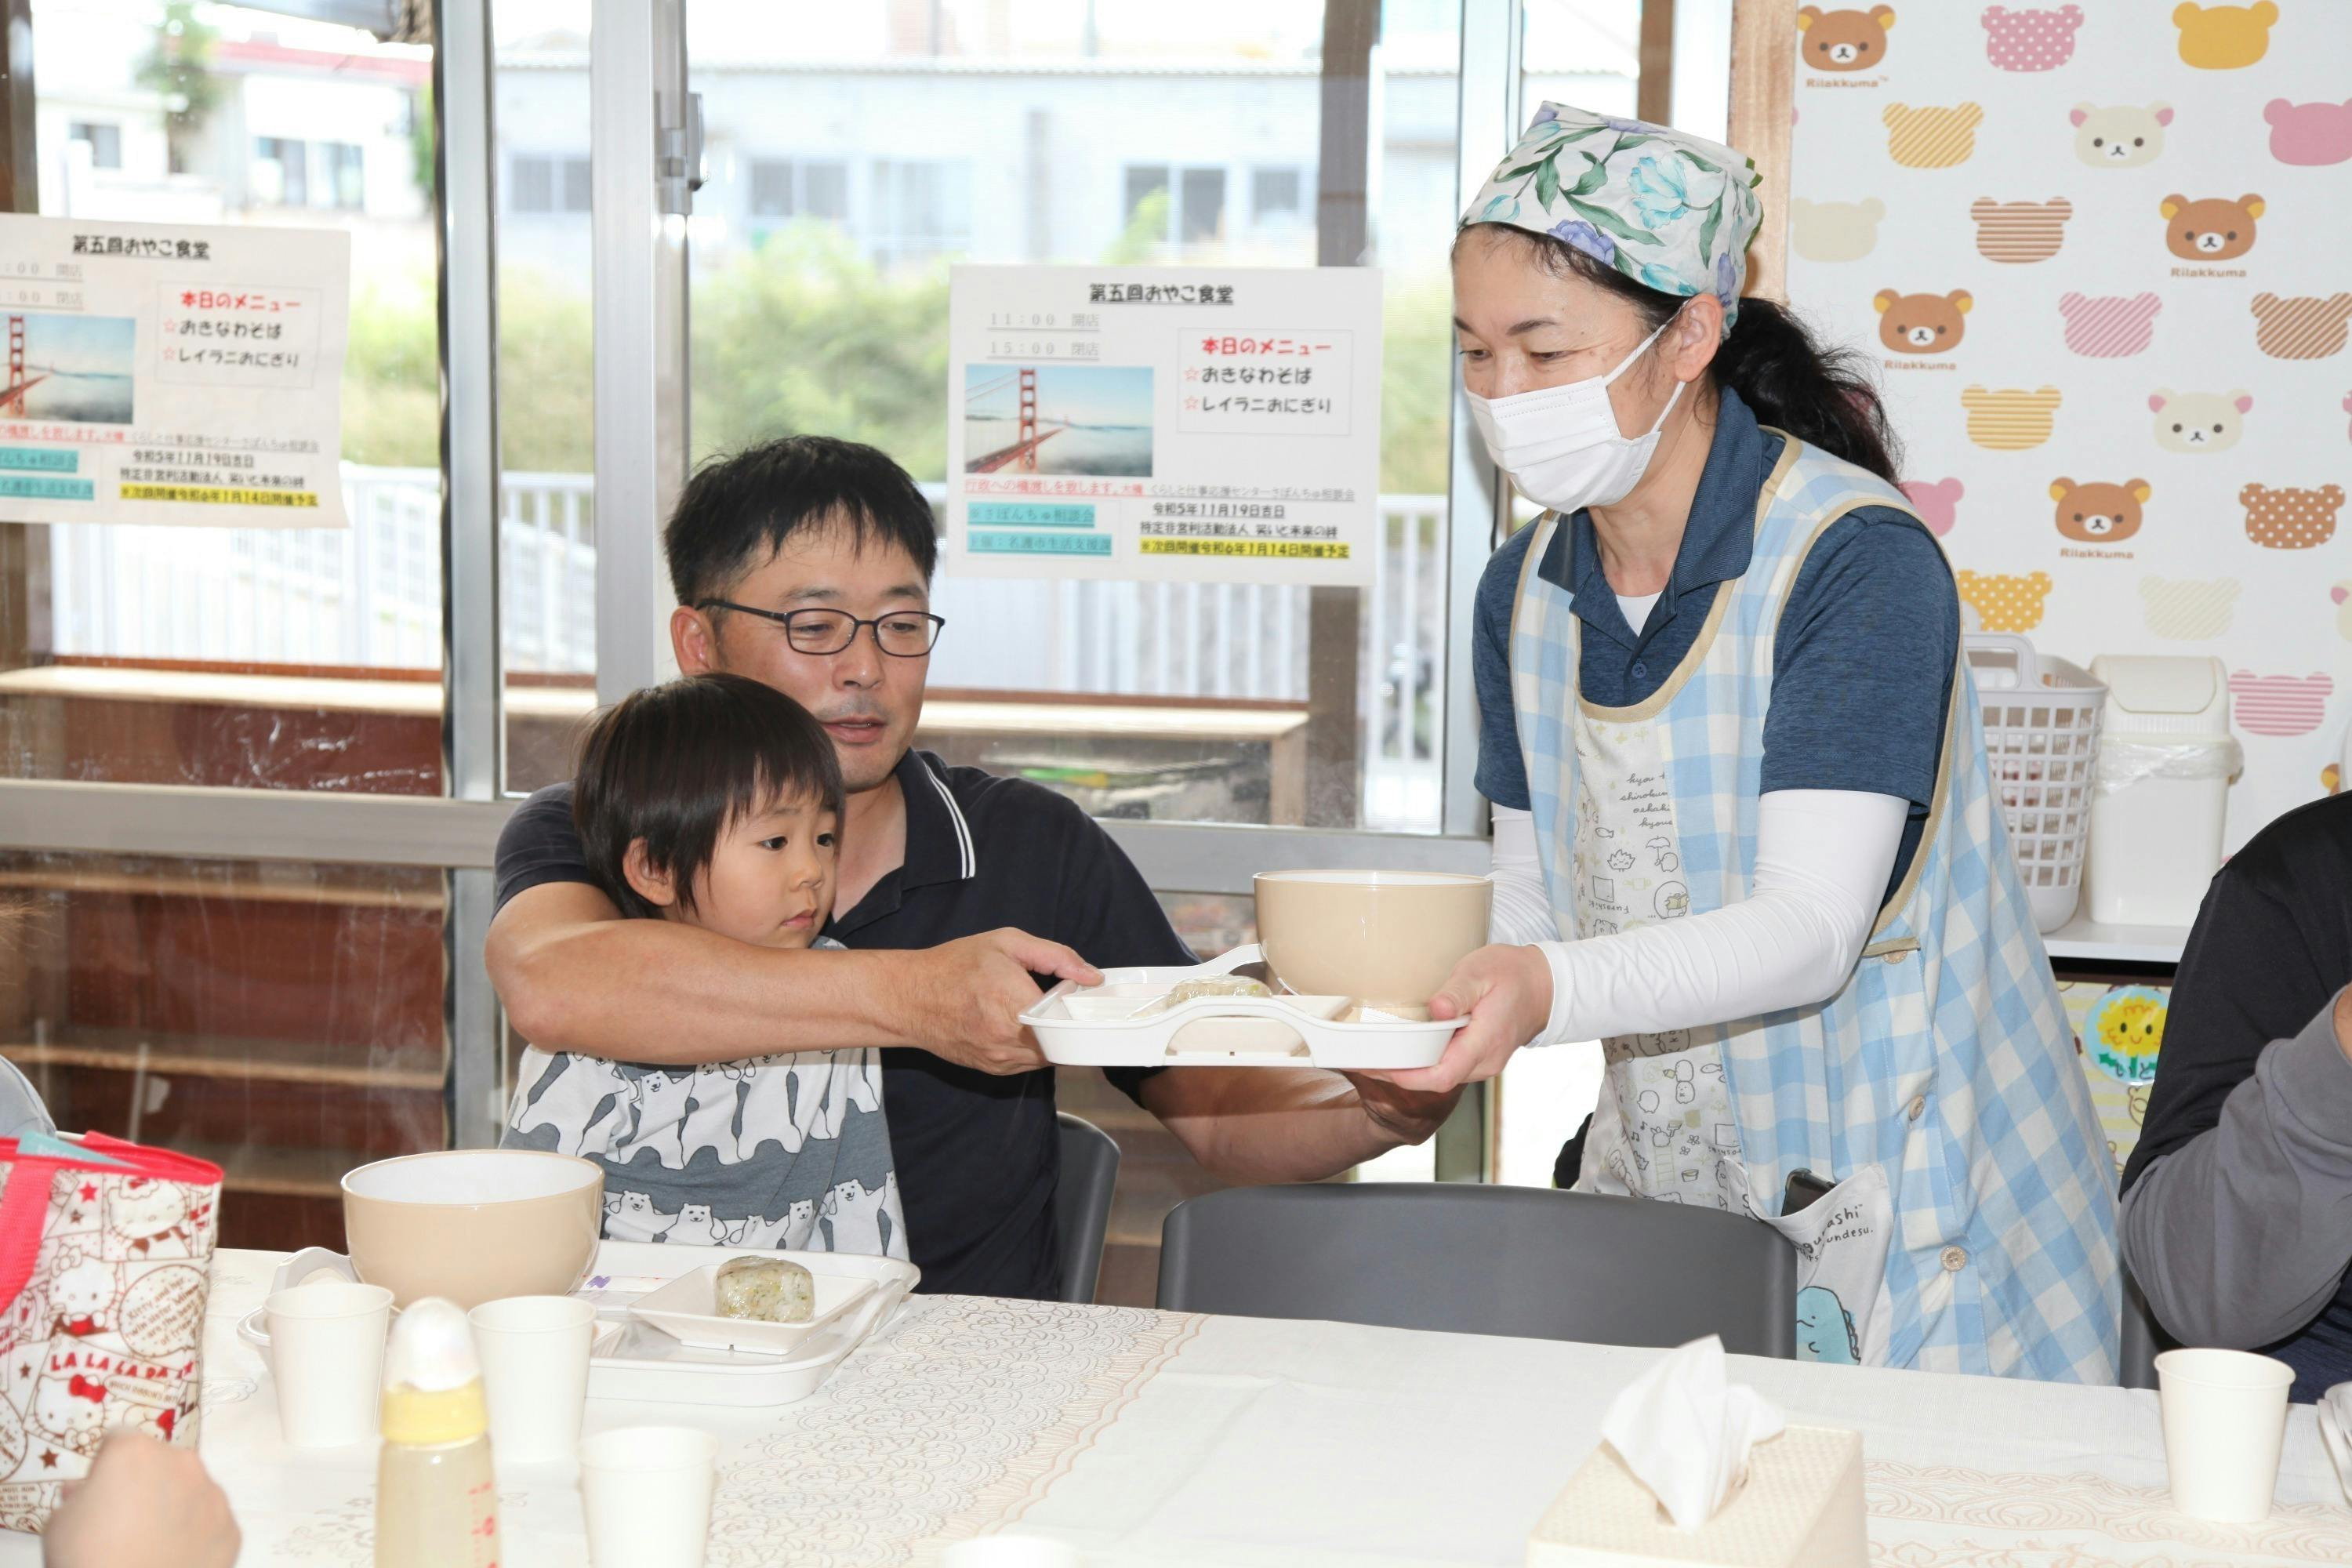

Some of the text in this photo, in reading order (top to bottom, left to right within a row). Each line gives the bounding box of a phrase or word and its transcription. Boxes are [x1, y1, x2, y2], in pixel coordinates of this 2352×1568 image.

[74, 235, 209, 260] 第五回おやこ食堂
[2170, 267, 2247, 277] Rilakkuma
[181, 291, 301, 311] 本日のメニュー
[1090, 284, 1234, 303] 第五回おやこ食堂
[180, 320, 282, 339] おきなわそば
[1202, 337, 1331, 355] 本日のメニュー
[180, 348, 299, 367] レイラニおにぎり
[1885, 360, 1957, 370] Rilakkuma
[1202, 366, 1312, 384] おきなわそば
[1203, 396, 1330, 413] レイラニおにぎり
[2060, 548, 2134, 559] Rilakkuma
[50, 1352, 78, 1371] LA
[85, 1353, 110, 1371] LA
[114, 1361, 138, 1377] LA
